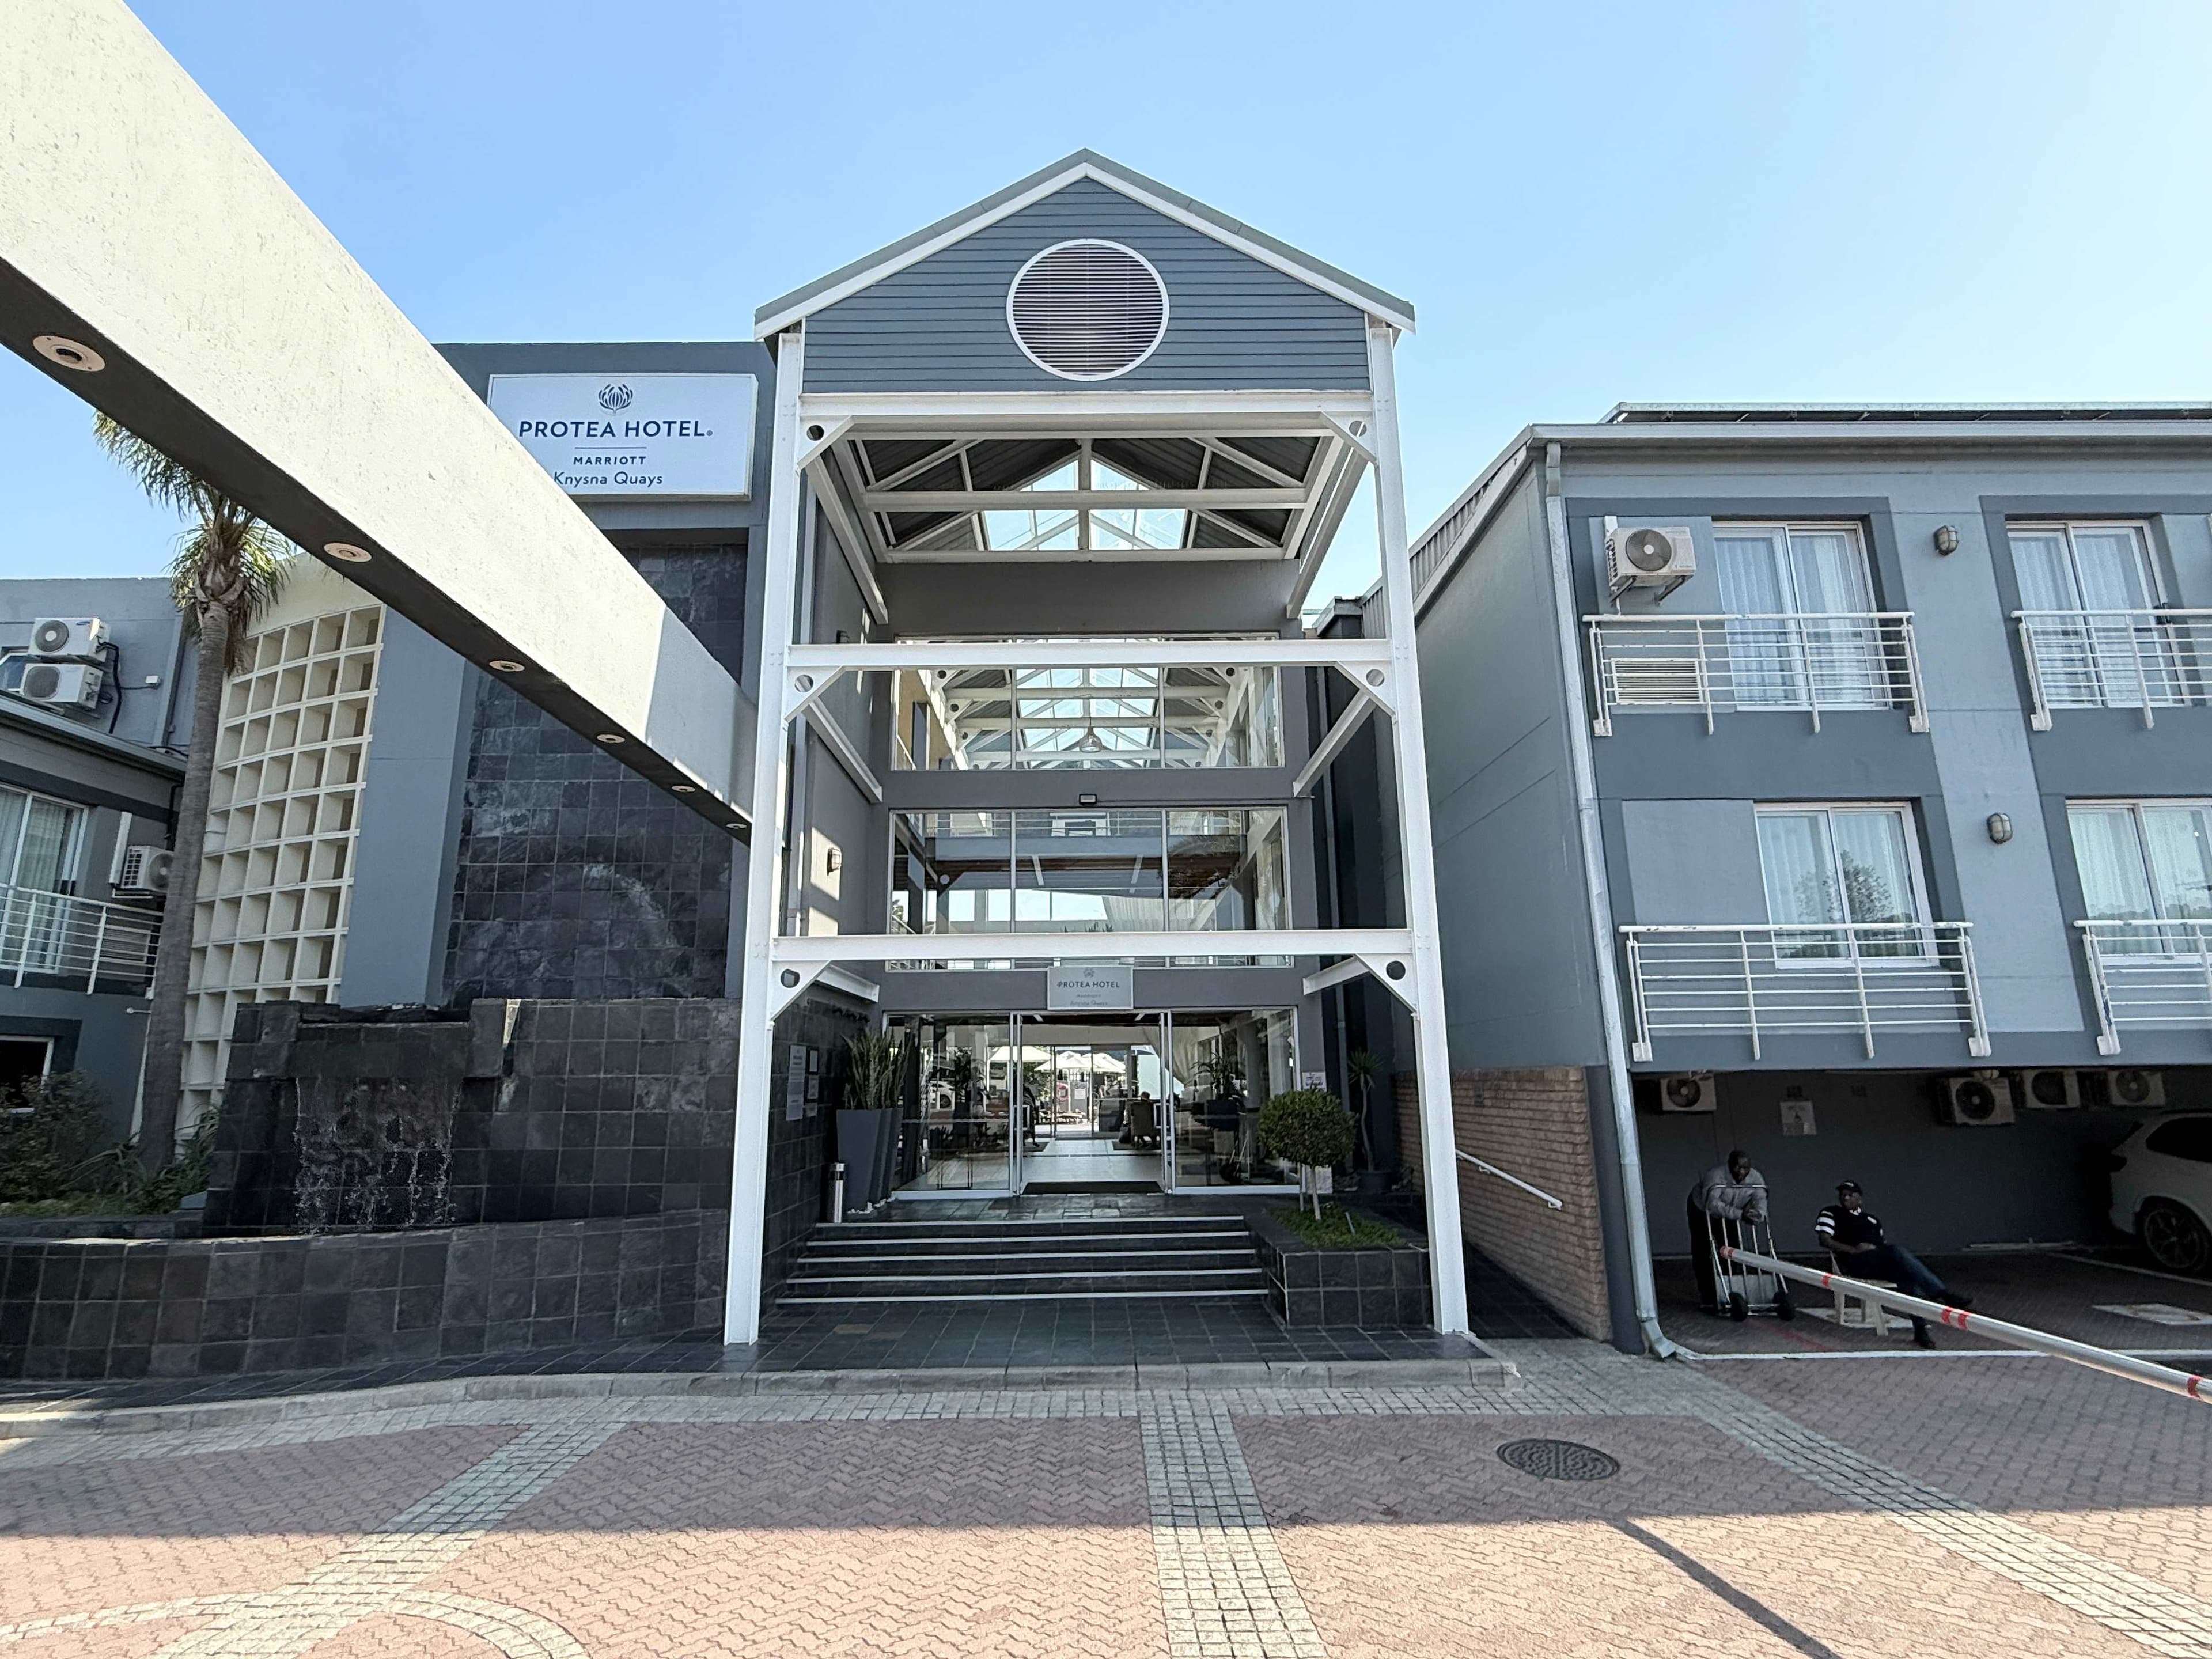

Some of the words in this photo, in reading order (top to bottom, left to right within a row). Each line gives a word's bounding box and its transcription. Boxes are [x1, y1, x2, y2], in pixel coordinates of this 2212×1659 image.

[519, 421, 616, 438] PROTEA
[573, 456, 646, 465] MARRIOTT
[554, 471, 608, 488] Knysna
[614, 471, 663, 488] Quays
